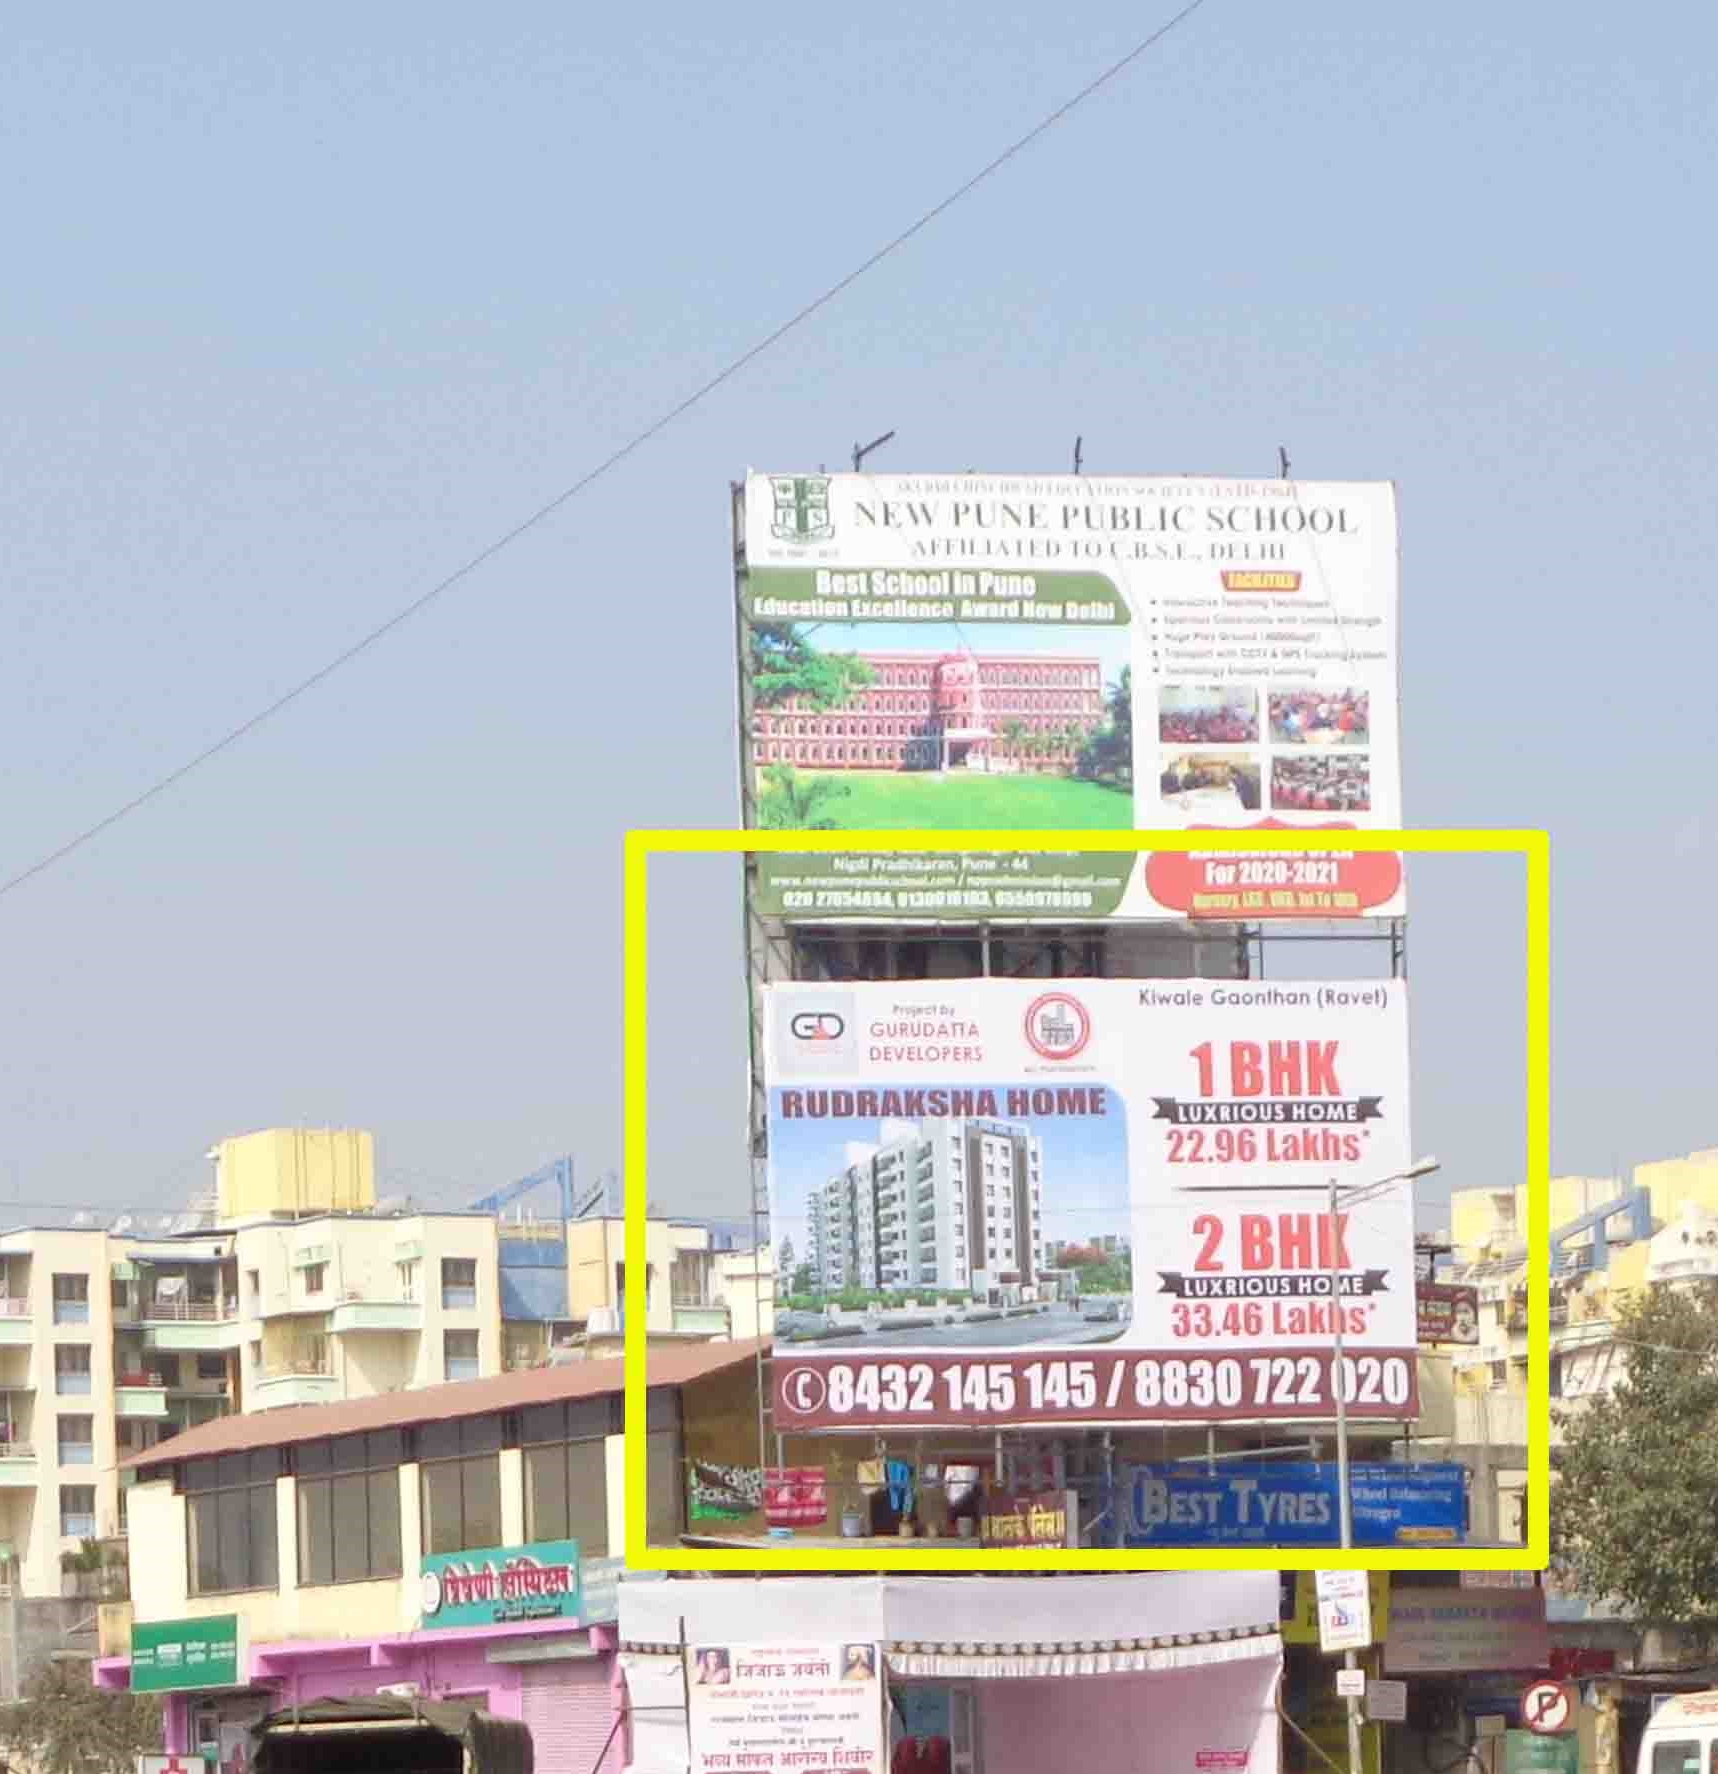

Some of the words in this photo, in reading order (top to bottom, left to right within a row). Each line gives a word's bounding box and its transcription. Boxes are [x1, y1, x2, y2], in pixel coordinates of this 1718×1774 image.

[854, 500, 935, 528] NEW
[953, 501, 1049, 530] PUNE
[1062, 503, 1195, 532] PUBLIC
[1206, 504, 1359, 535] SCHOOL
[910, 537, 1062, 558] AFFILIATED
[1070, 540, 1102, 559] TO
[1210, 541, 1285, 561] DELHI
[815, 568, 869, 597] Best
[871, 568, 950, 597] School
[978, 571, 1036, 598] Pune
[753, 596, 848, 618] Education
[851, 598, 955, 618] Excellence
[960, 600, 1020, 619] Award
[1023, 601, 1063, 619] New
[1064, 602, 1116, 621] Delhi
[1204, 860, 1236, 885] For
[1239, 860, 1339, 885] 2020-2021
[893, 1003, 937, 1019] Project
[939, 1004, 956, 1019] by
[1138, 988, 1204, 1007] Kiwale
[1210, 988, 1311, 1007] Gaonthan
[1316, 987, 1389, 1009] (Ravet)
[869, 1021, 980, 1039] GURUDATTA
[869, 1045, 983, 1063] DEVELOPERS
[1189, 1039, 1214, 1098] 1
[1229, 1038, 1343, 1098] BHK
[781, 1087, 999, 1119] RUDRAKSHA
[1006, 1086, 1107, 1117] HOME
[1178, 1103, 1285, 1123] LUXRIOUS
[1291, 1103, 1358, 1122] HOME
[1166, 1127, 1258, 1163] 22.96
[1192, 1213, 1225, 1272] 2
[1239, 1212, 1352, 1271] BHK
[1183, 1277, 1291, 1297] LUXRIOUS
[1298, 1276, 1364, 1295] HOME
[1171, 1302, 1263, 1338] 33.46
[827, 1364, 935, 1413] 8432
[942, 1363, 1016, 1412] 145
[1023, 1361, 1095, 1410] 145
[1105, 1359, 1126, 1409] /
[1134, 1357, 1243, 1408] 8830
[1248, 1357, 1323, 1406] 722
[1330, 1356, 1410, 1406] 020
[1143, 1477, 1223, 1526] BEST
[1229, 1478, 1331, 1526] TYRES
